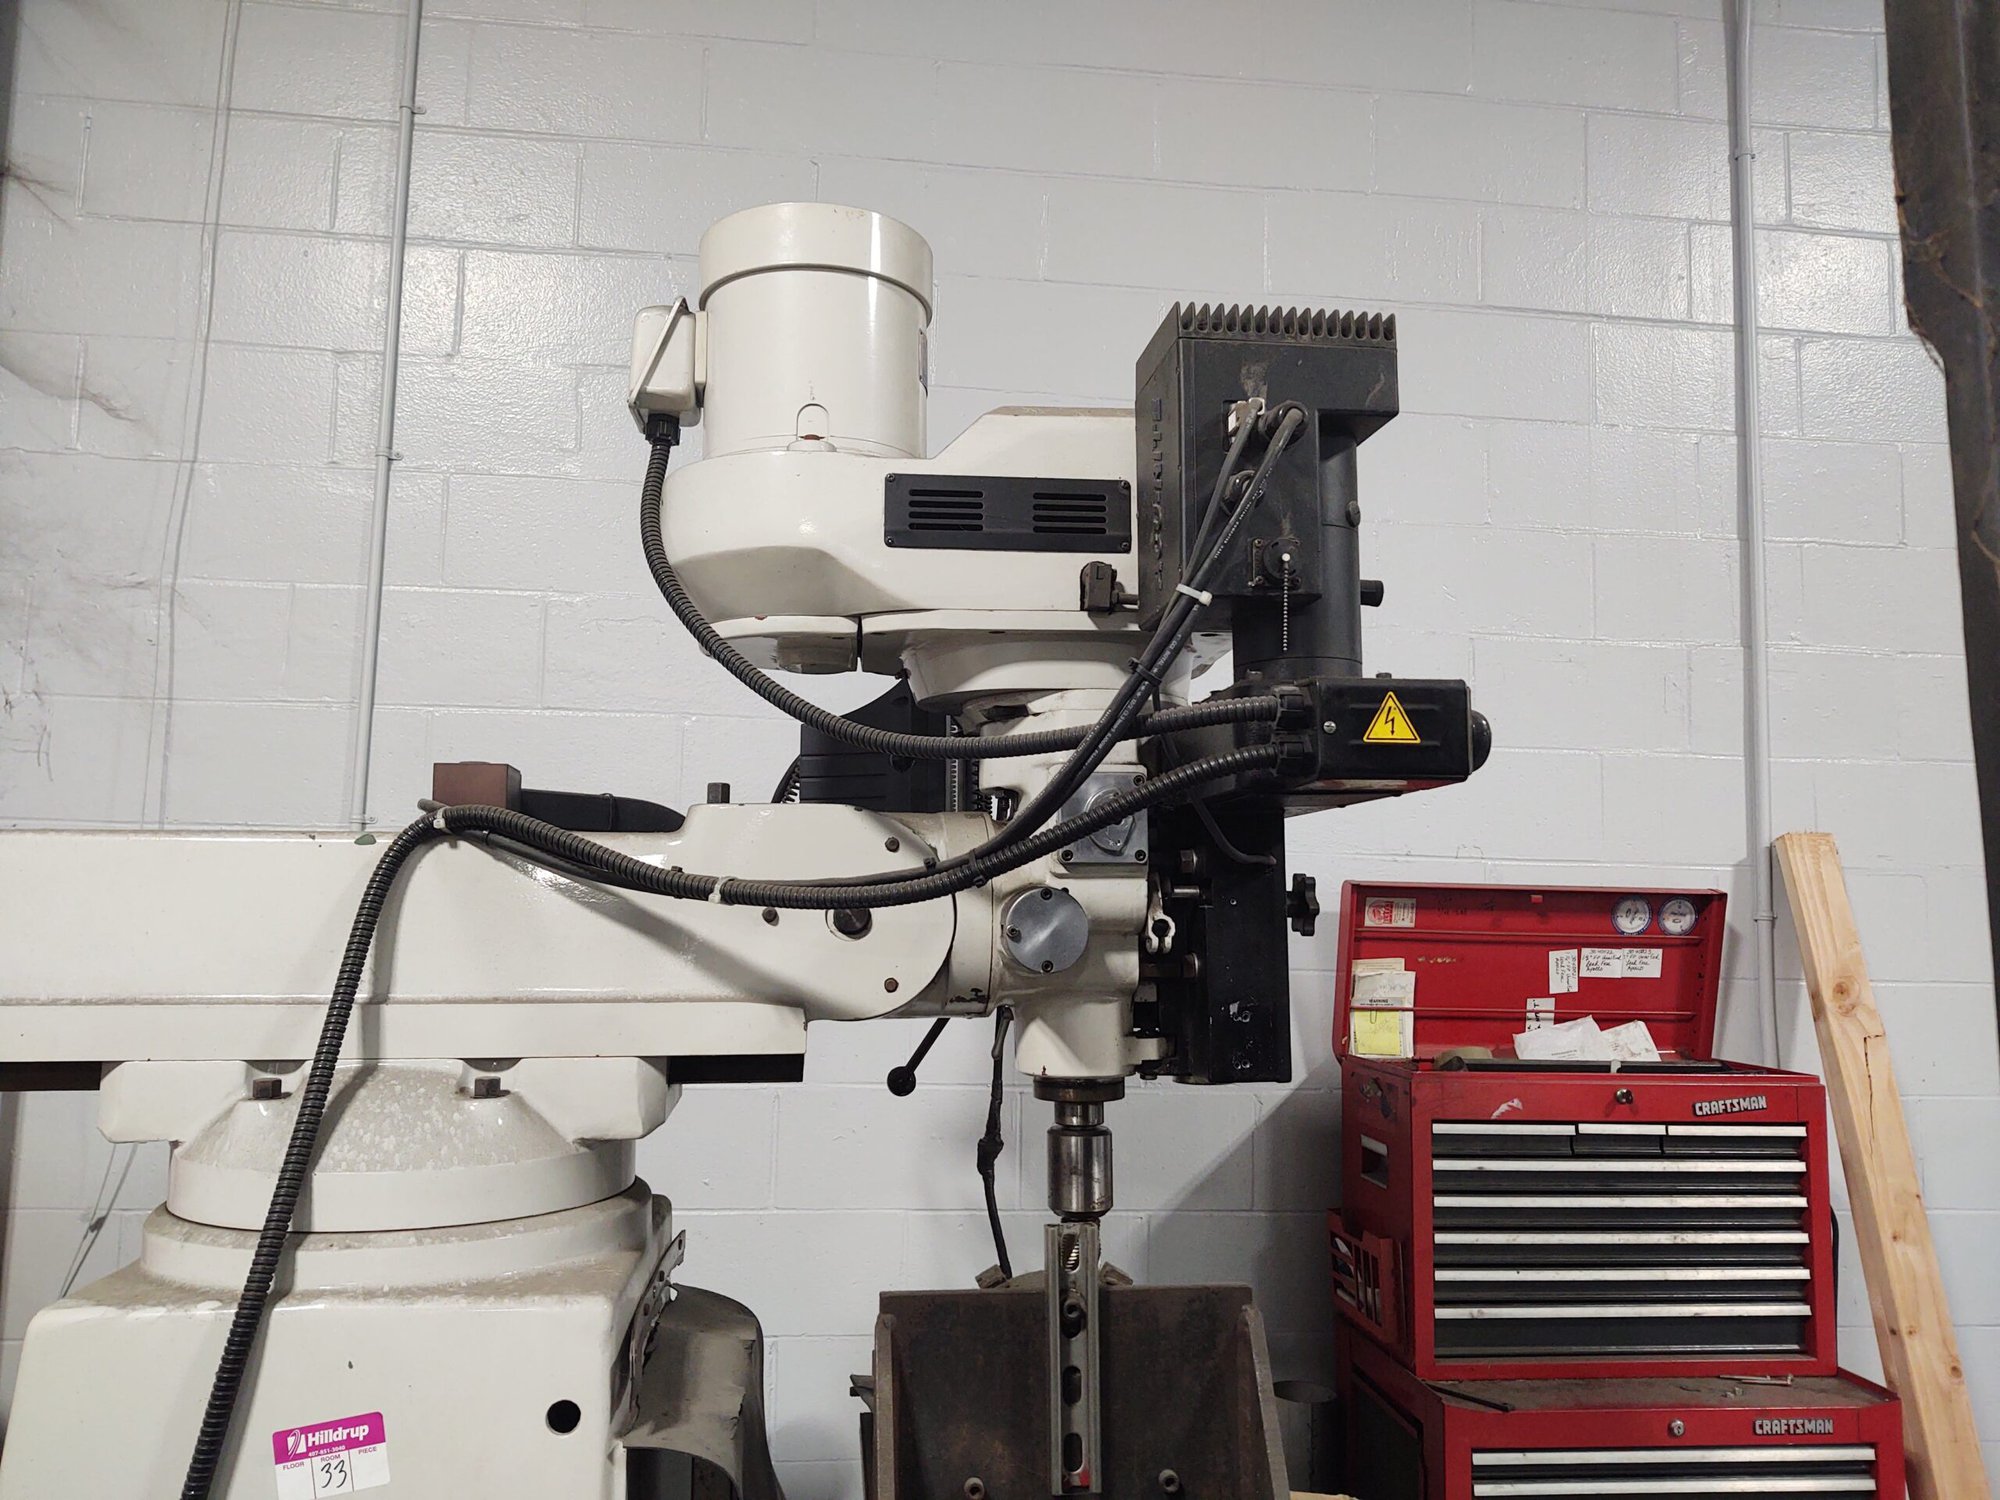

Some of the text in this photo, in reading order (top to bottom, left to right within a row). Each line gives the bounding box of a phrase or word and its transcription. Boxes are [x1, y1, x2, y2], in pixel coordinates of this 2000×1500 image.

[1694, 1096, 1767, 1116] CRAFTSMAN
[307, 1425, 369, 1447] Hilldrup
[1754, 1419, 1834, 1435] CRAFTSMAN
[283, 1446, 377, 1470] FLOOR ROOM PIECE
[321, 1459, 348, 1488] 33
